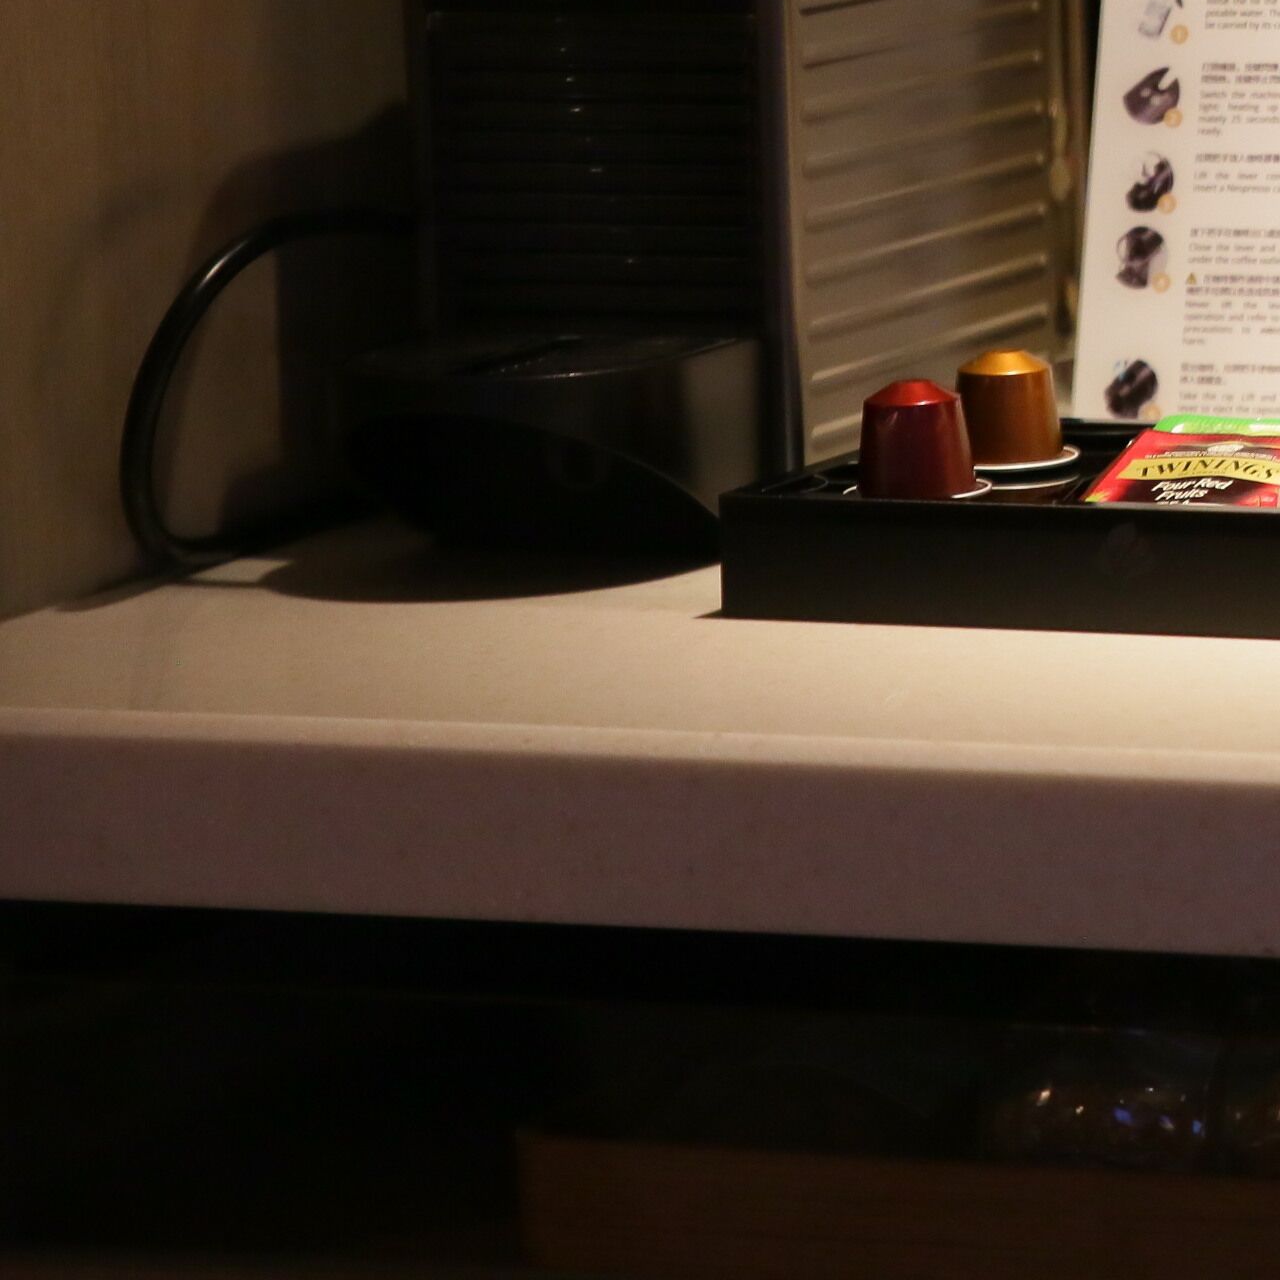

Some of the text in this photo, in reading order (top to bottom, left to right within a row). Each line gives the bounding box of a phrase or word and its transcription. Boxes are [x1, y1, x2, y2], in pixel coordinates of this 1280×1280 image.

[1136, 457, 1280, 480] TWININGS
[1150, 477, 1235, 491] Four Red
[1154, 489, 1209, 501] Fruits
